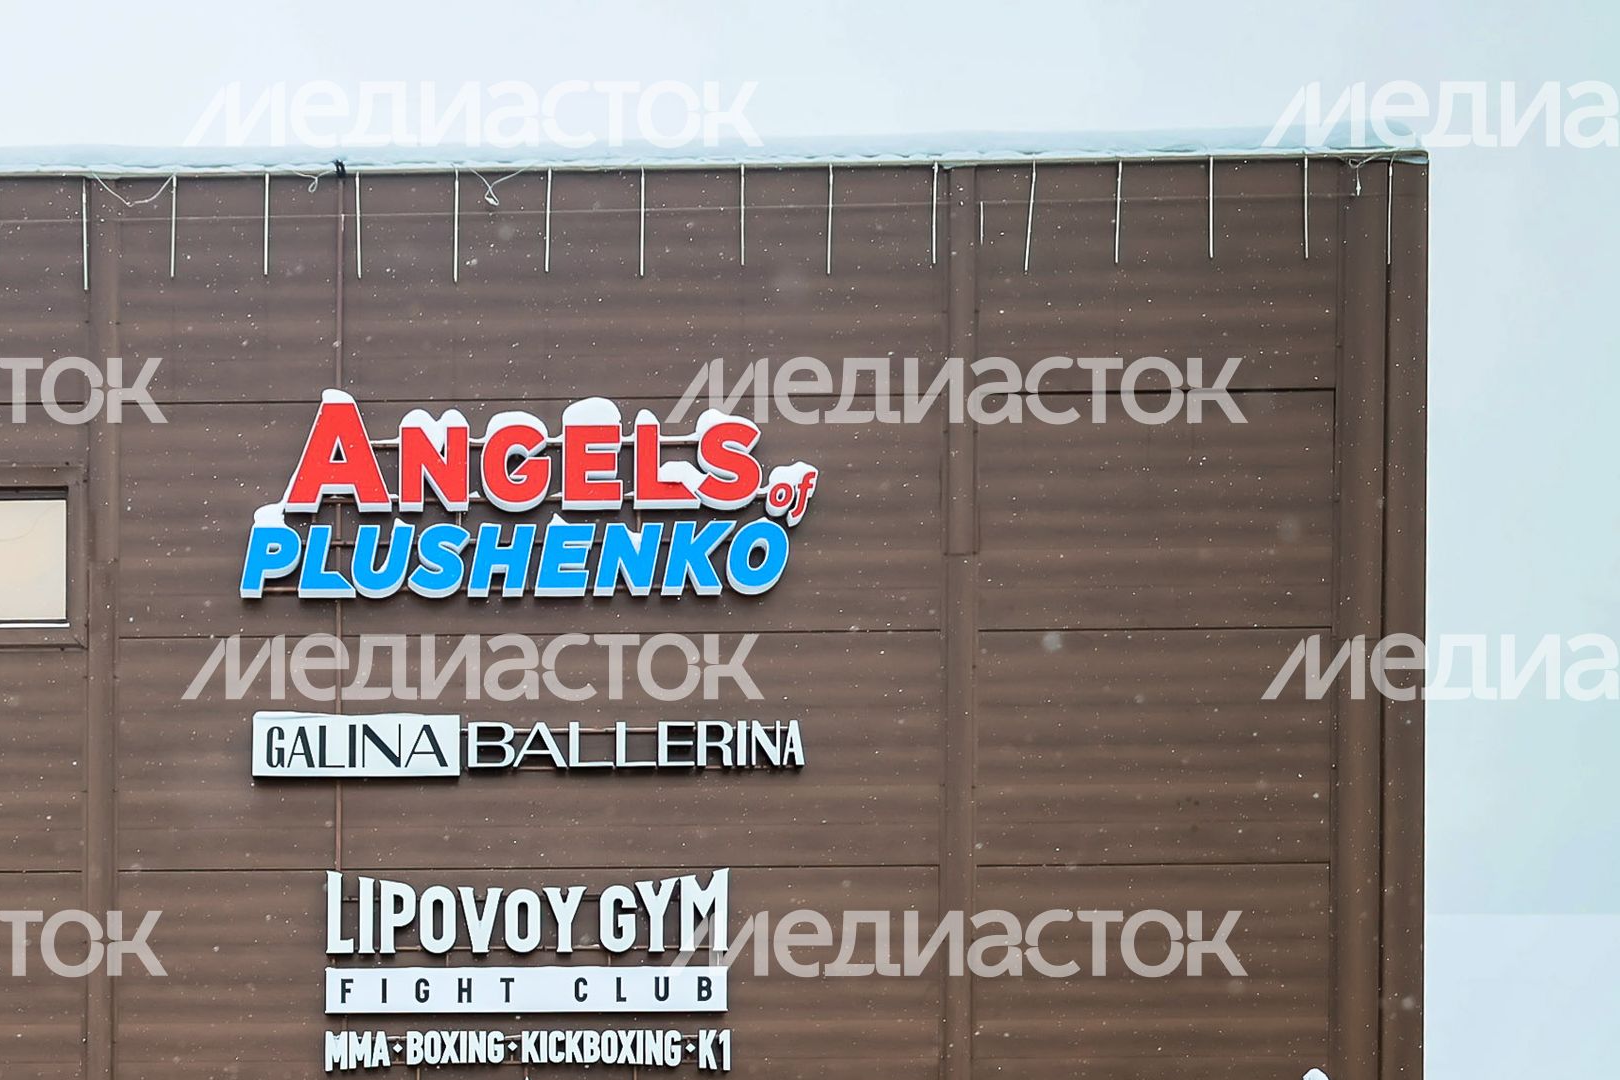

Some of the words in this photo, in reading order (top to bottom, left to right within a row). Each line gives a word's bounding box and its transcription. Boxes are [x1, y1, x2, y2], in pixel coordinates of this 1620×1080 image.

[766, 466, 818, 526] of
[239, 518, 790, 598] PLUSHENKO
[265, 723, 450, 769] GALINA
[467, 718, 805, 768] BALLERINA
[325, 870, 588, 955] LIPOVOY
[599, 867, 730, 953] GYM
[340, 977, 515, 1004] FIGHT
[574, 976, 713, 1002] CLUB
